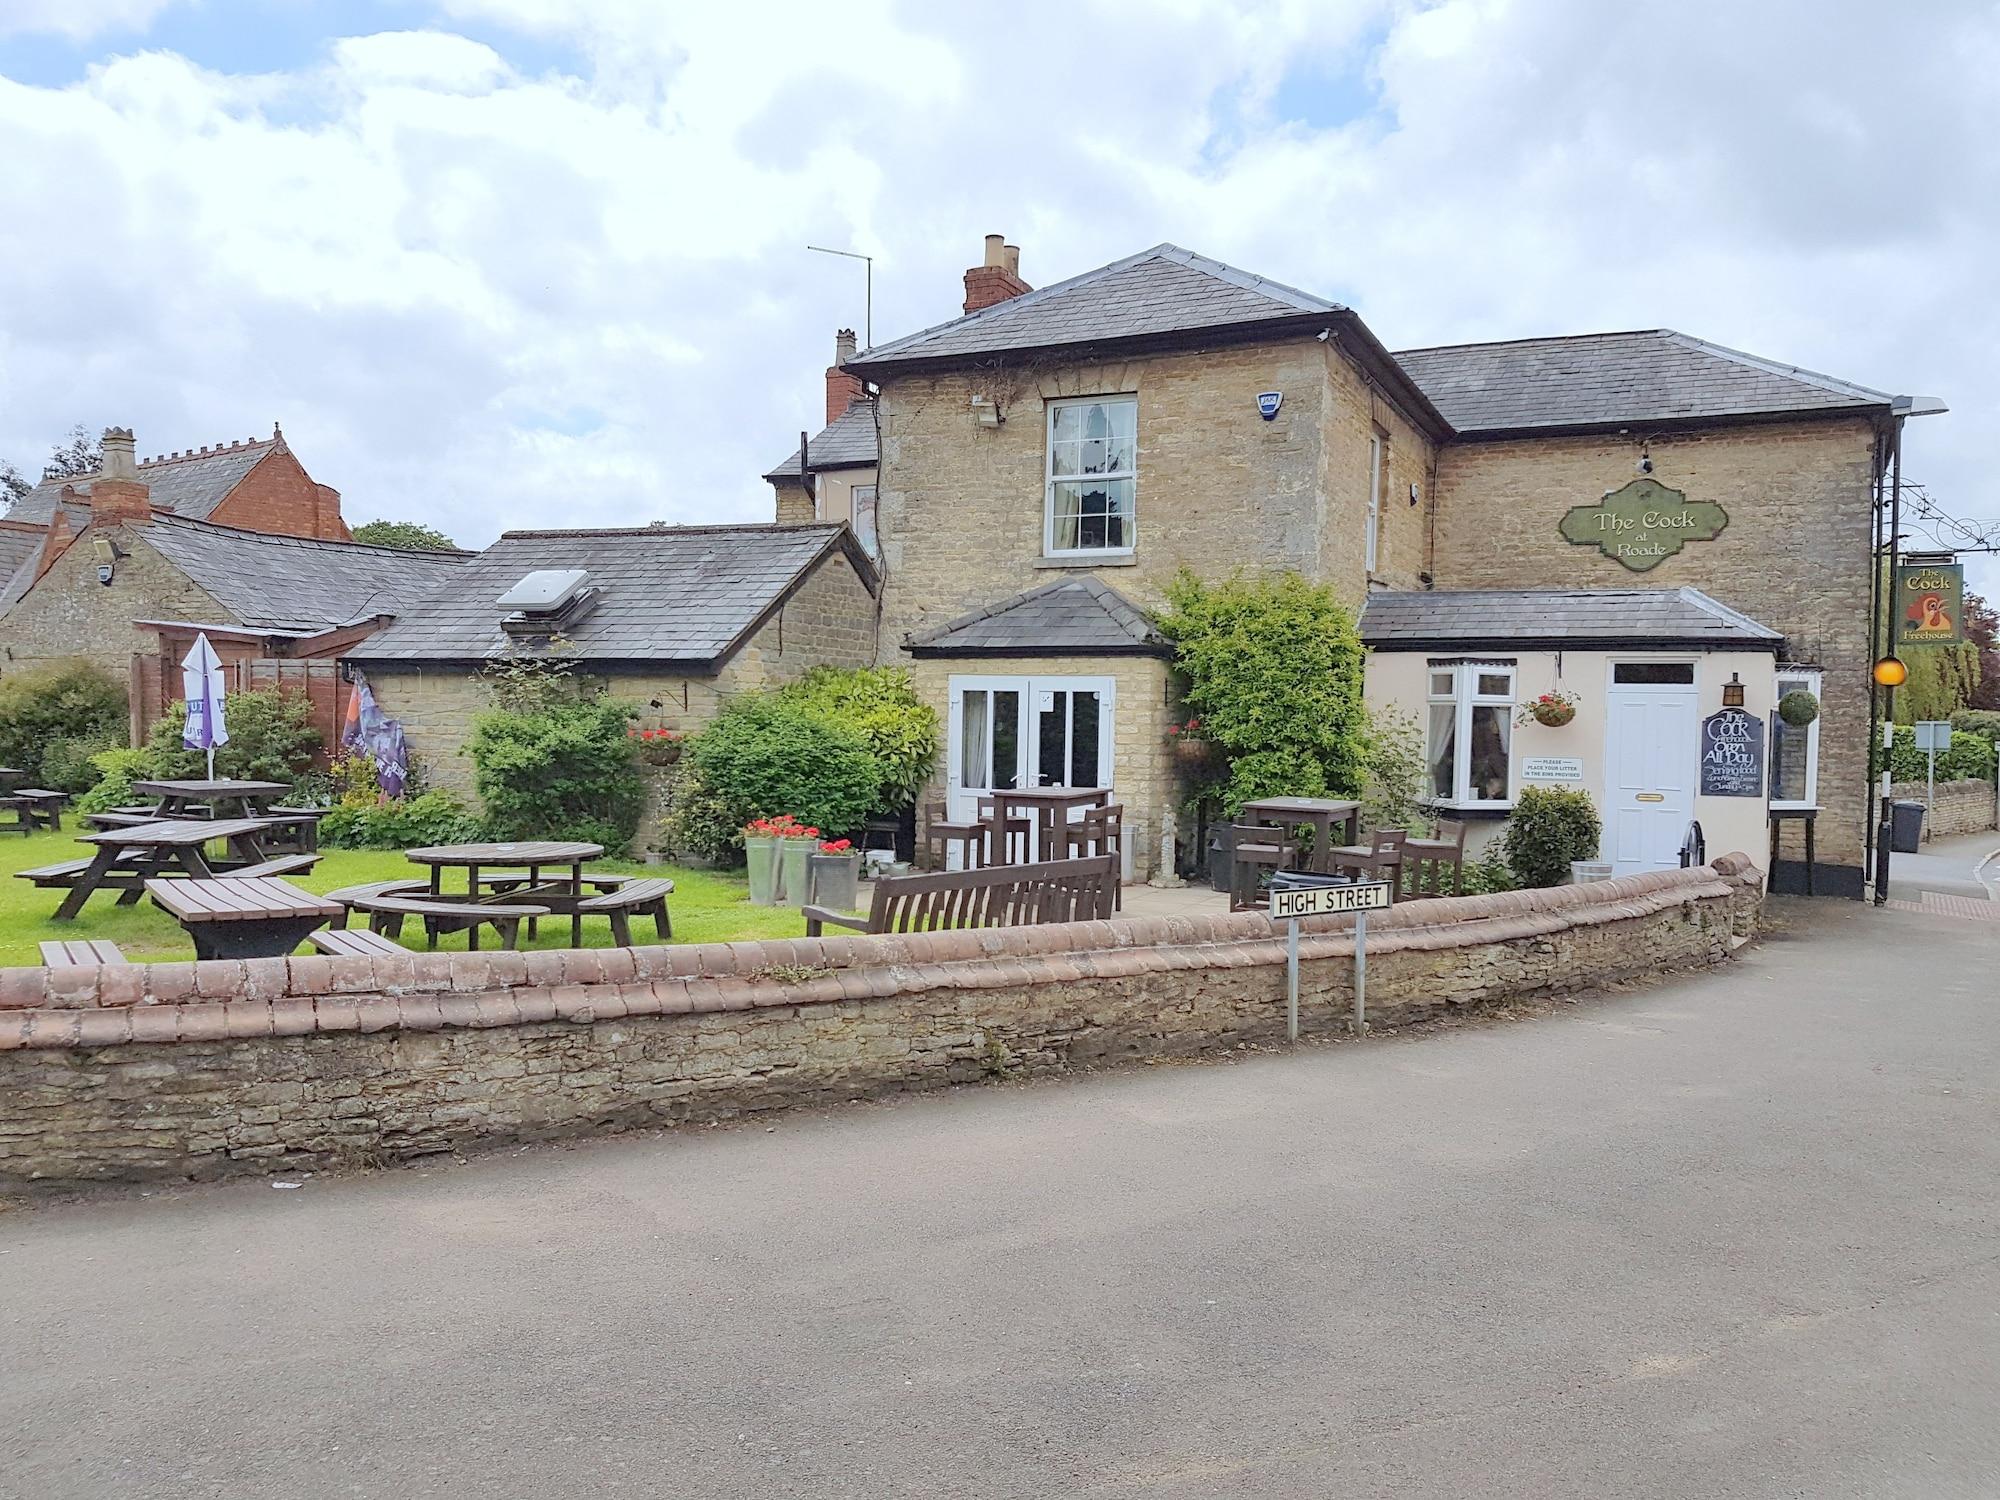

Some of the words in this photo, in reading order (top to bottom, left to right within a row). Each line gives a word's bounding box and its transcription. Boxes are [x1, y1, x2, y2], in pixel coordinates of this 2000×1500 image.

[1592, 512, 1635, 535] The
[1642, 510, 1696, 529] Cock
[1635, 532, 1648, 542] at
[1617, 542, 1666, 557] Roade
[1920, 568, 1939, 577] The
[1906, 576, 1951, 590] Cock
[1903, 630, 1954, 641] Freehouse
[1278, 891, 1317, 914] HIGH
[1325, 887, 1382, 910] STREET
